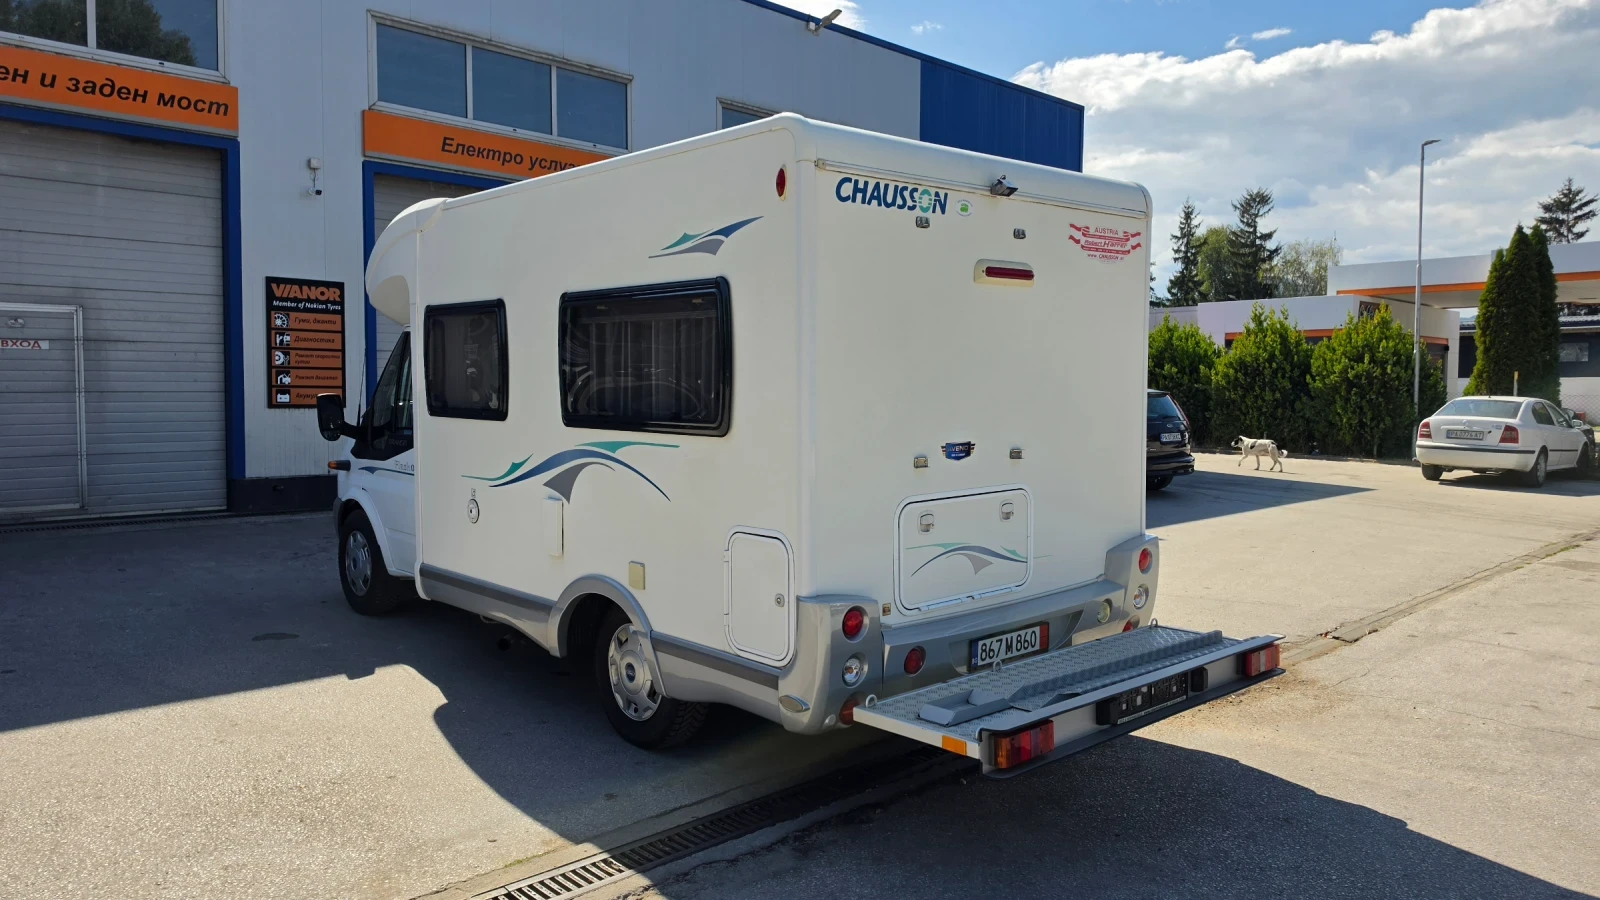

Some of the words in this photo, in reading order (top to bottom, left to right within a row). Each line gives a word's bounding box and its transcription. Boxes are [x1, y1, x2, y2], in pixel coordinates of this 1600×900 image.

[39, 72, 57, 89] и
[65, 77, 149, 104] заден
[156, 92, 229, 117] мост
[441, 136, 524, 166] Електро
[528, 155, 580, 172] услу
[835, 176, 949, 215] CHAUSSON
[1094, 227, 1119, 236] AUSTRIA
[270, 283, 341, 301] VIANOR
[272, 300, 297, 308] Member
[327, 303, 341, 311] Tyres
[294, 317, 311, 325] Гуми,
[312, 317, 337, 325] джанти
[1, 340, 42, 349] ВХОД
[294, 335, 335, 344] Диагностика
